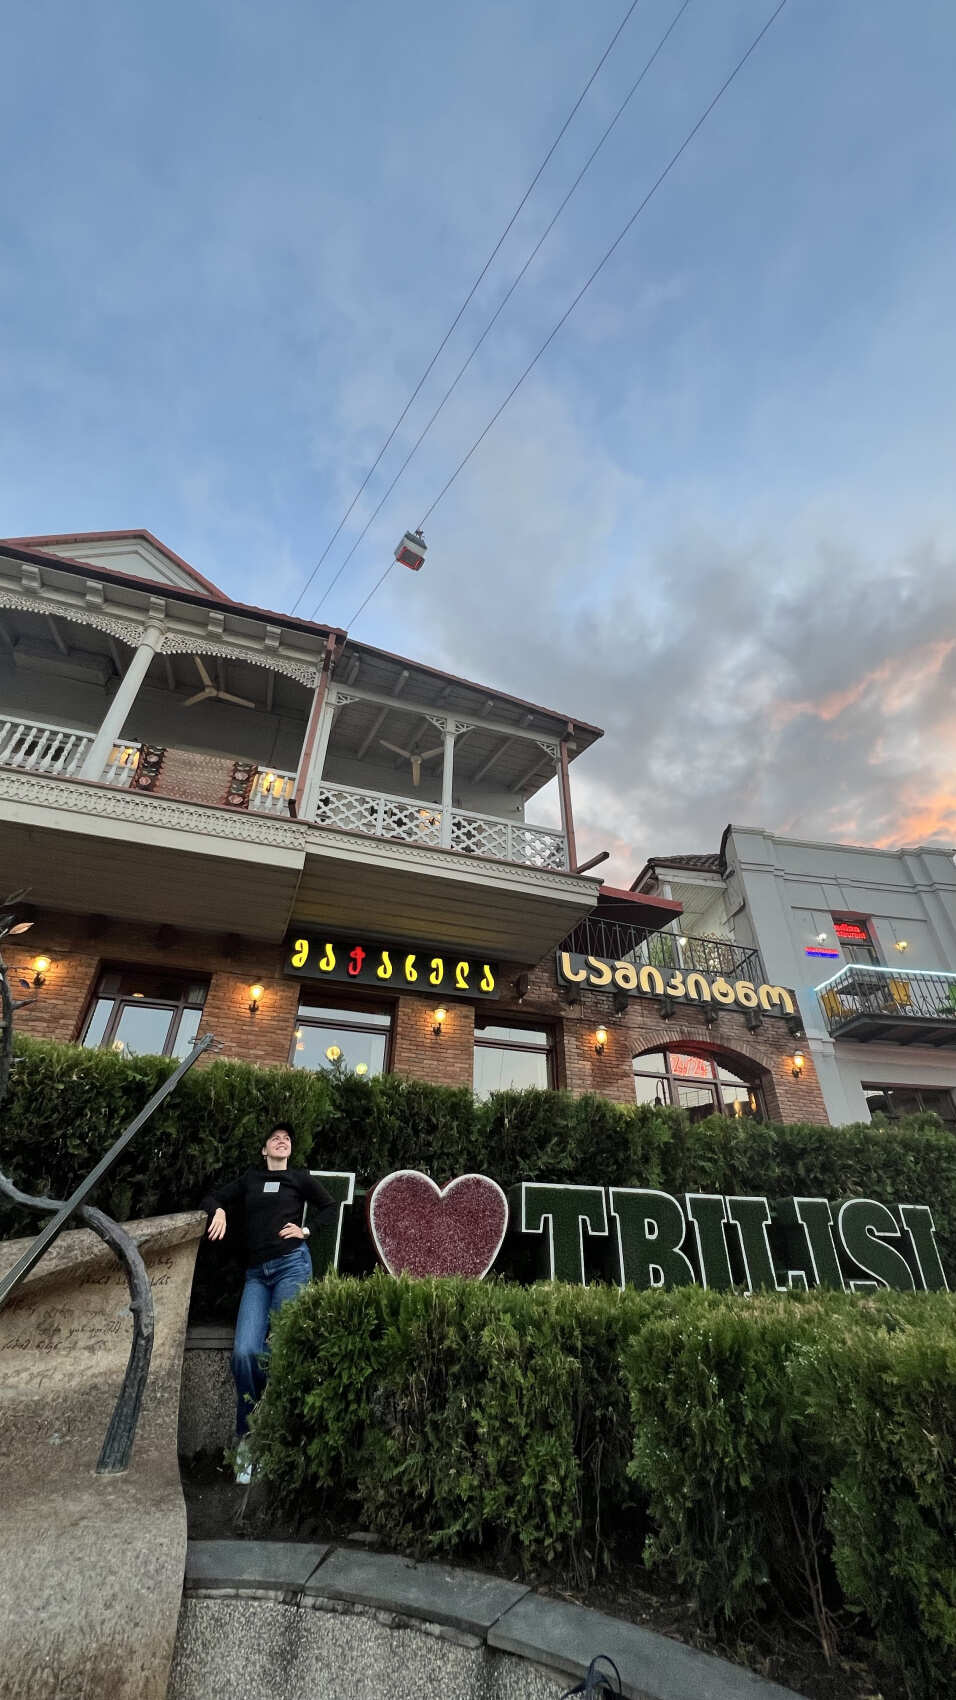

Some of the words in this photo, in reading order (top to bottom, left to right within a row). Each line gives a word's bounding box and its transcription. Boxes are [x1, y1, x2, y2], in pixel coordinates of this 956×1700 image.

[291, 938, 495, 993] მაჭახელა
[560, 951, 795, 1015] სამიკიტნო
[302, 1169, 356, 1274] I
[521, 1181, 951, 1295] TBILISI
